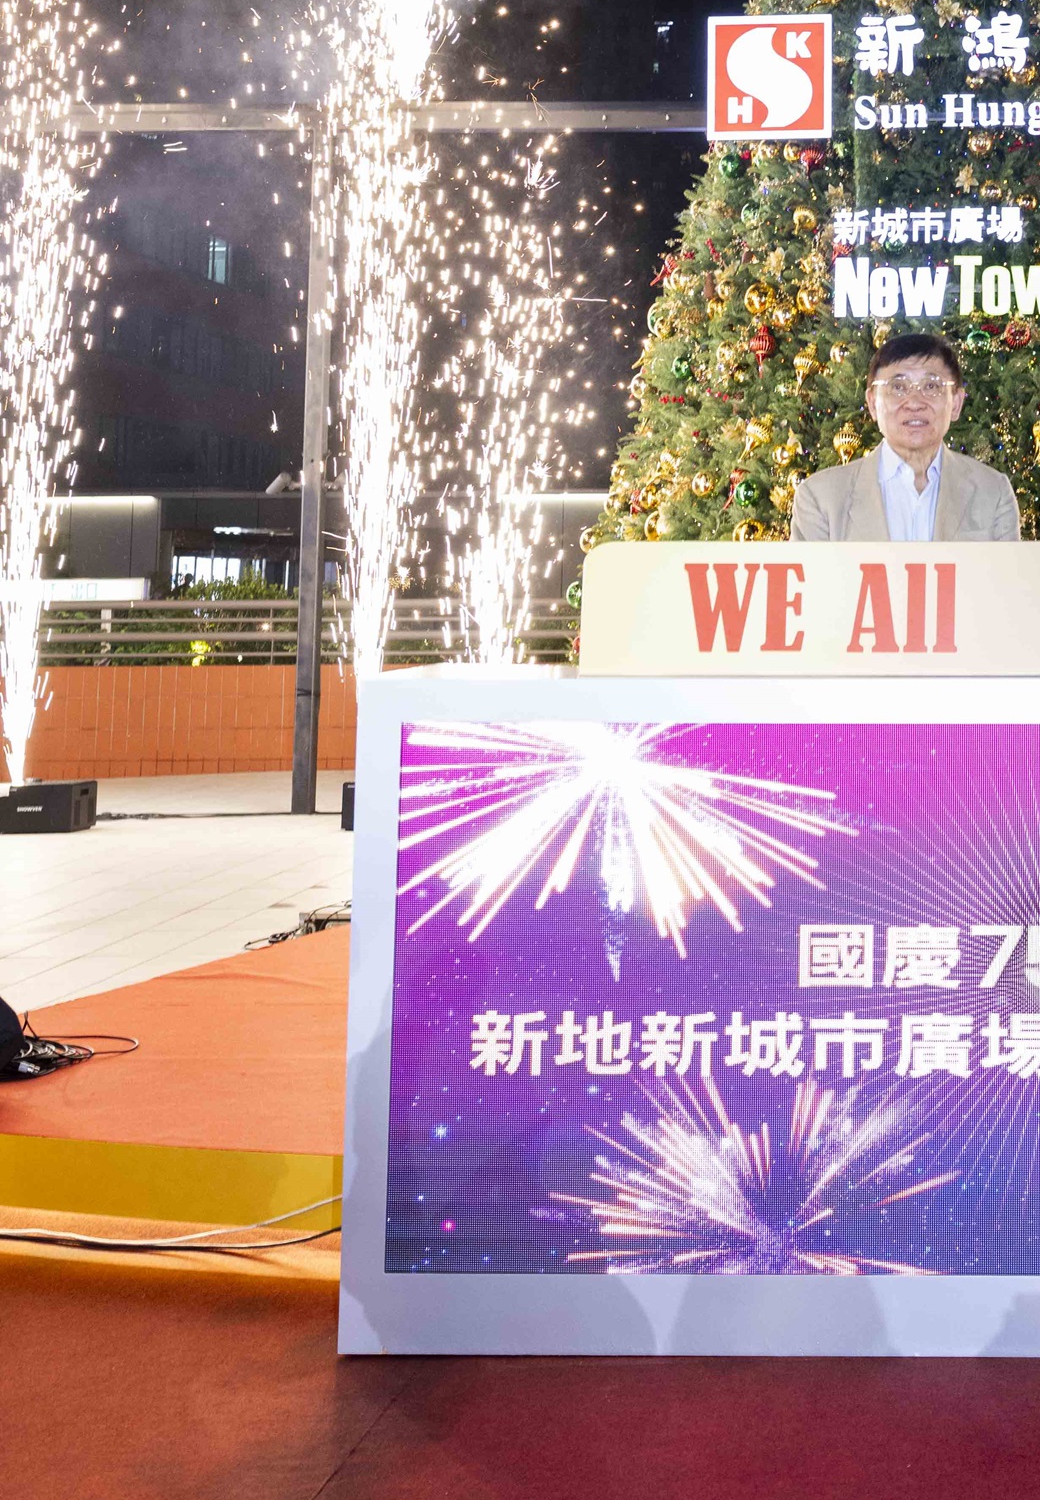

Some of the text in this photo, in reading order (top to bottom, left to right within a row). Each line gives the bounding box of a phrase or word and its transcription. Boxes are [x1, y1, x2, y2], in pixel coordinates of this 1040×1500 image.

[854, 95, 929, 131] Sun
[833, 206, 1024, 244] 新城市廣場
[684, 563, 958, 653] WE All
